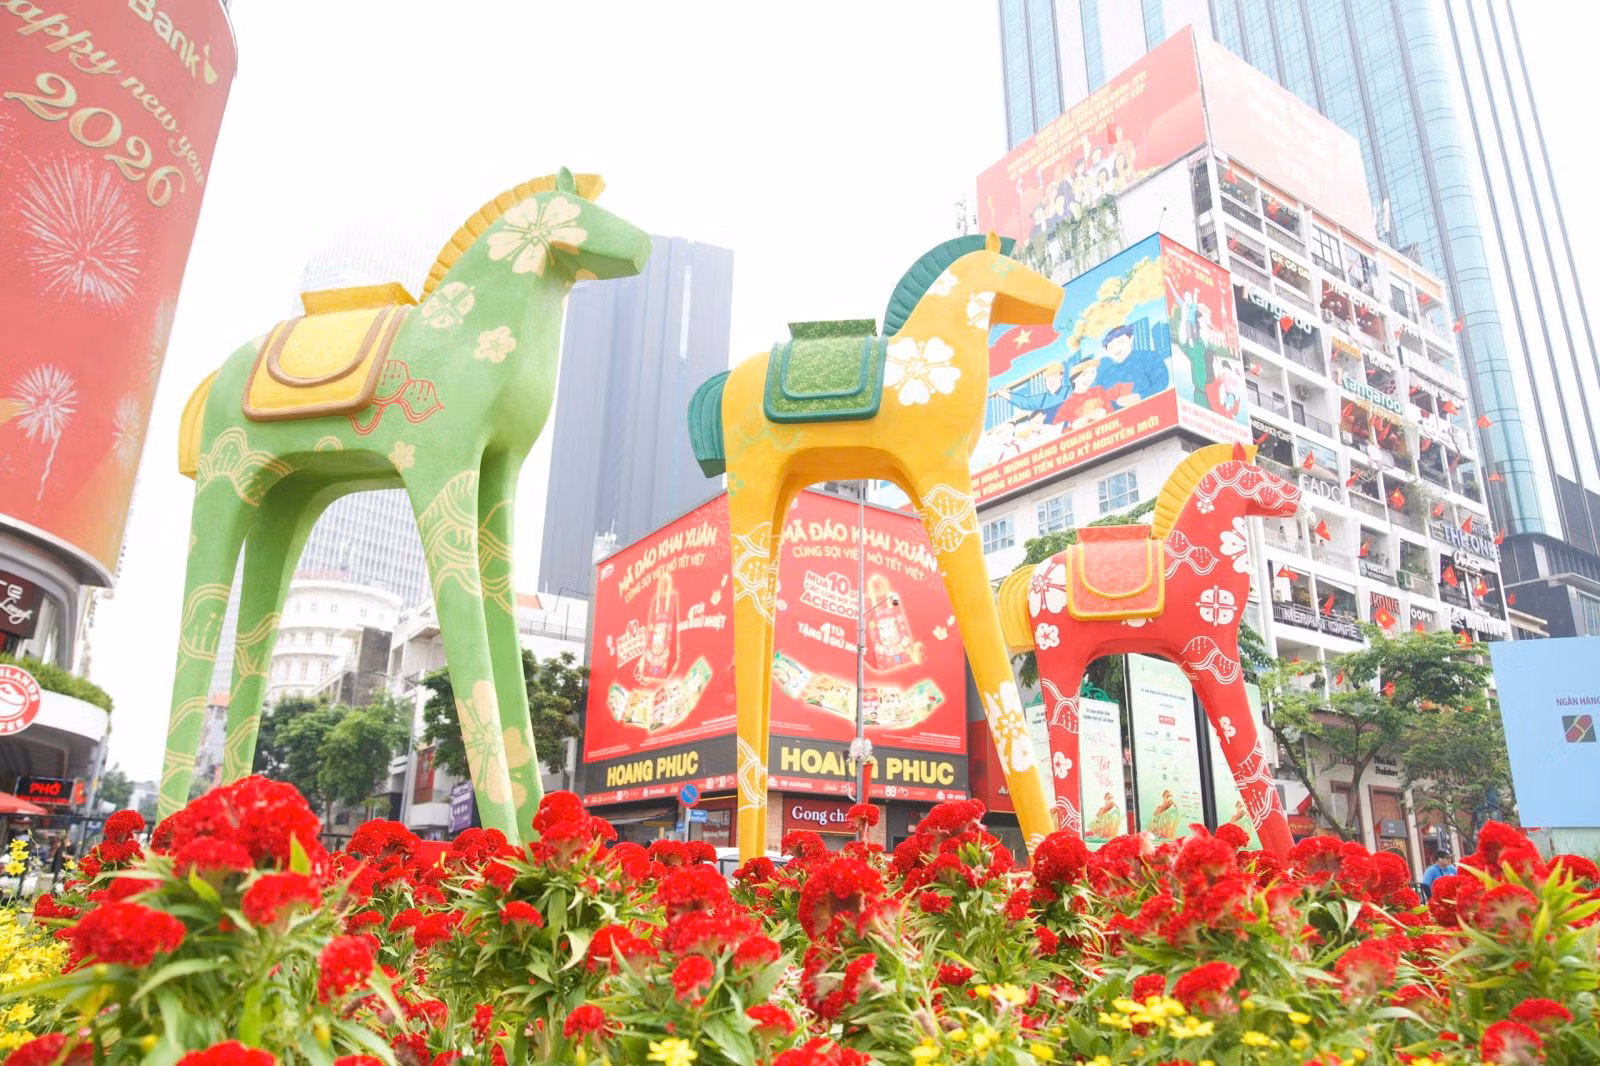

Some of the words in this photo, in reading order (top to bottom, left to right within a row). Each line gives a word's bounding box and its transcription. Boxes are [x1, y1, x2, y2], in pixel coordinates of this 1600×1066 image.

[0, 0, 122, 75] appy
[120, 76, 179, 133] new
[168, 136, 204, 188] year
[3, 72, 187, 208] 2026
[809, 518, 848, 543] ĐÁO
[893, 536, 938, 573] XUÂN
[828, 574, 850, 596] 10
[1556, 696, 1579, 706] NGÂN
[606, 755, 652, 788] HOANG
[656, 750, 699, 778] PHUC
[781, 747, 879, 777] HOAN
[886, 757, 954, 785] PHUC
[792, 805, 828, 826] Gong
[829, 808, 849, 823] ch
